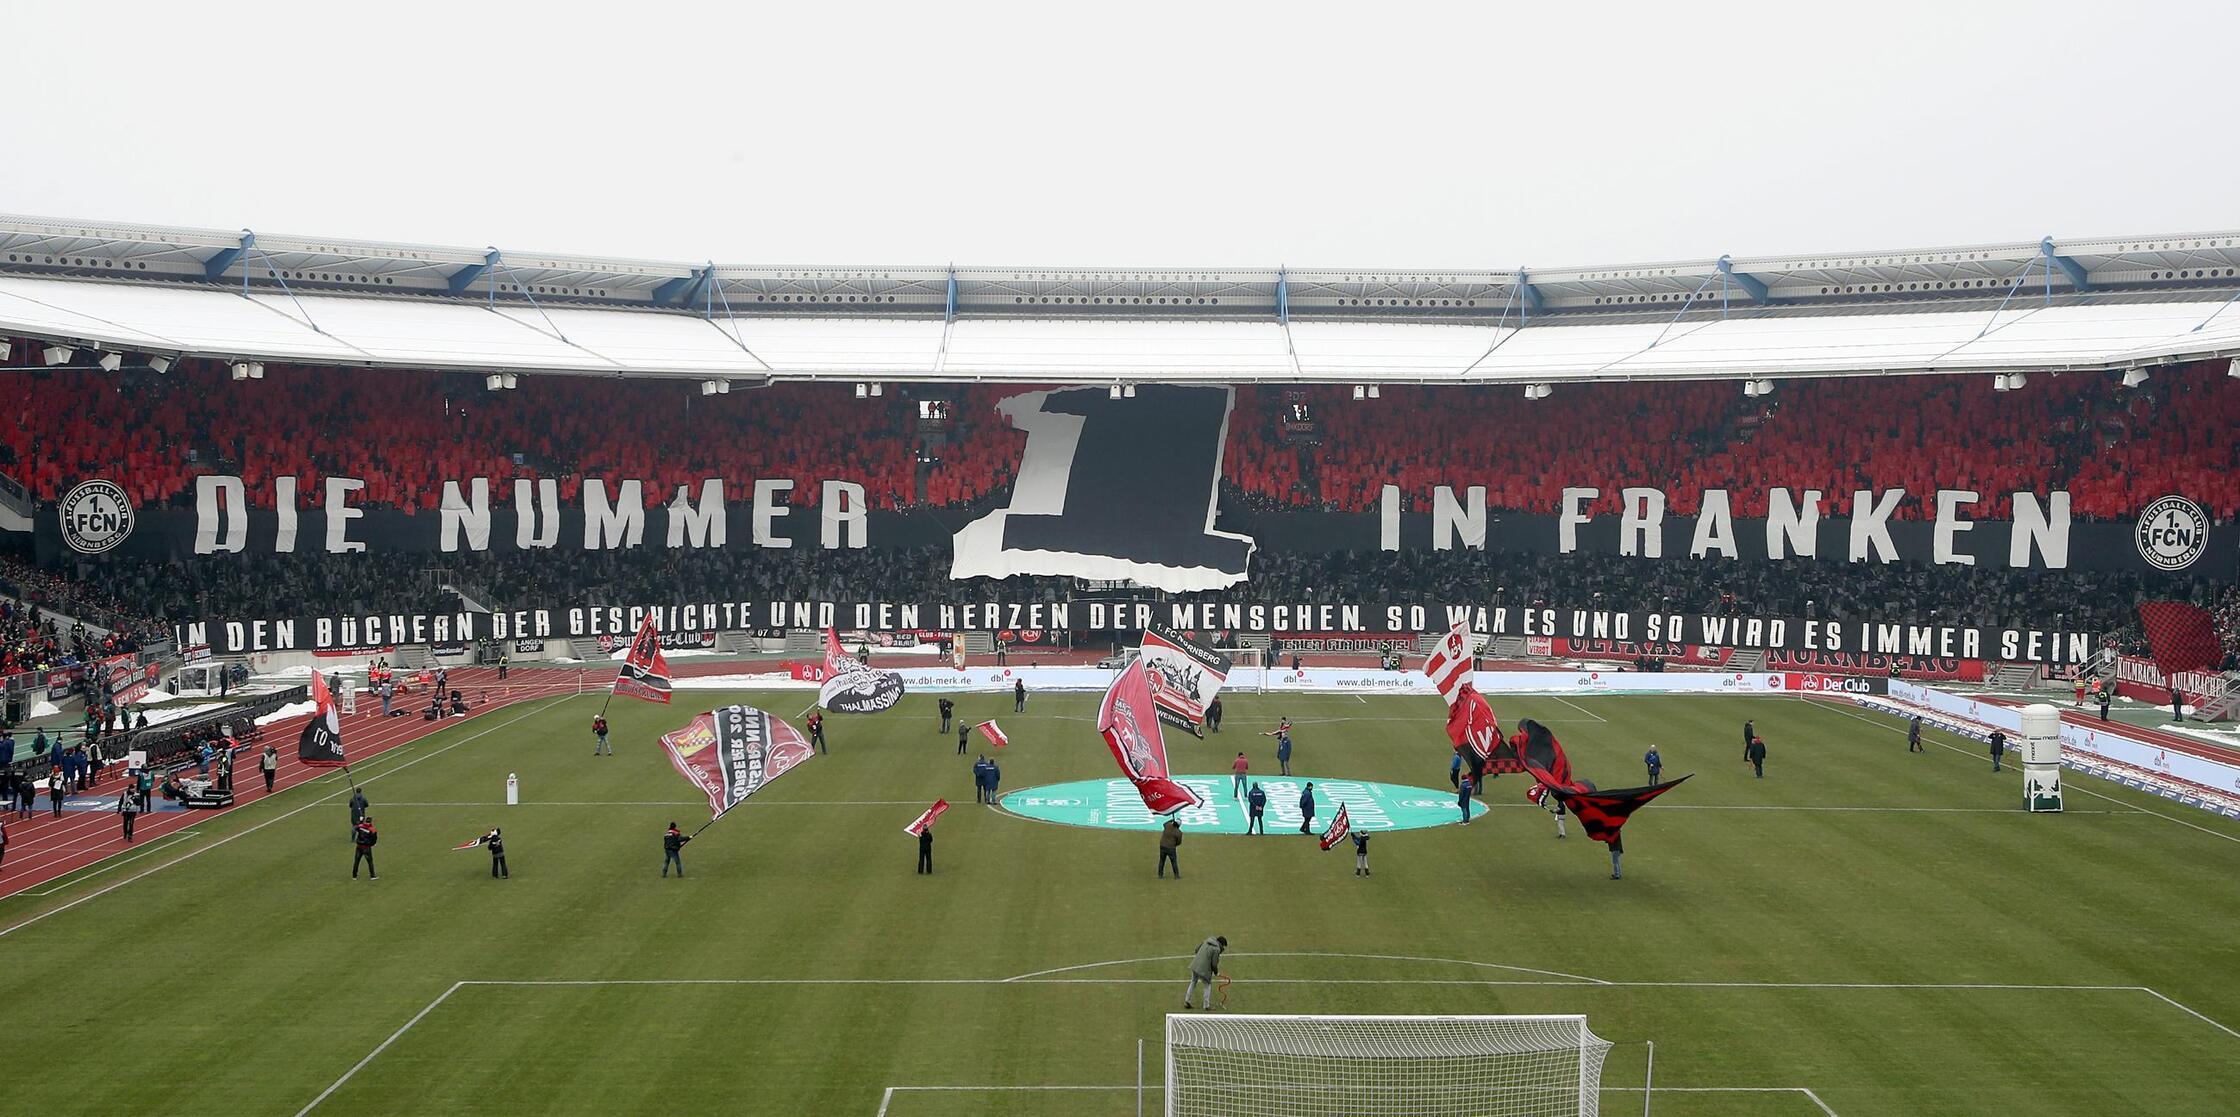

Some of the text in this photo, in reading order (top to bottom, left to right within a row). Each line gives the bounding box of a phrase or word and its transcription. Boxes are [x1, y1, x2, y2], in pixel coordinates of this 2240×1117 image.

[89, 495, 104, 513] 1.
[77, 514, 117, 532] FCN
[195, 476, 366, 554] DIE
[440, 478, 868, 552] NUMMER
[1381, 485, 1487, 551] IN
[1560, 488, 2071, 568] FRANKEN
[2166, 510, 2180, 528] 1.
[2152, 528, 2190, 546] FCN
[175, 602, 2088, 663] IN DEN BÜCHERN DER GESCHICHTE UND DEN HERZEN DER MENSCHEN. SO WAR ES UND SO WIRD ES IMMER SEIN
[1164, 628, 1176, 639] FC
[516, 638, 544, 647] LANGEN
[520, 644, 539, 652] DORF
[903, 676, 972, 686] ww.dbl-merk.de
[990, 673, 1004, 682] dbl
[1283, 675, 1297, 684] dbl
[1336, 677, 1414, 687] www.dbl-merk.de
[1578, 677, 1591, 686] dbl
[1723, 678, 1736, 687] dbl
[1823, 678, 1870, 692] Der Club
